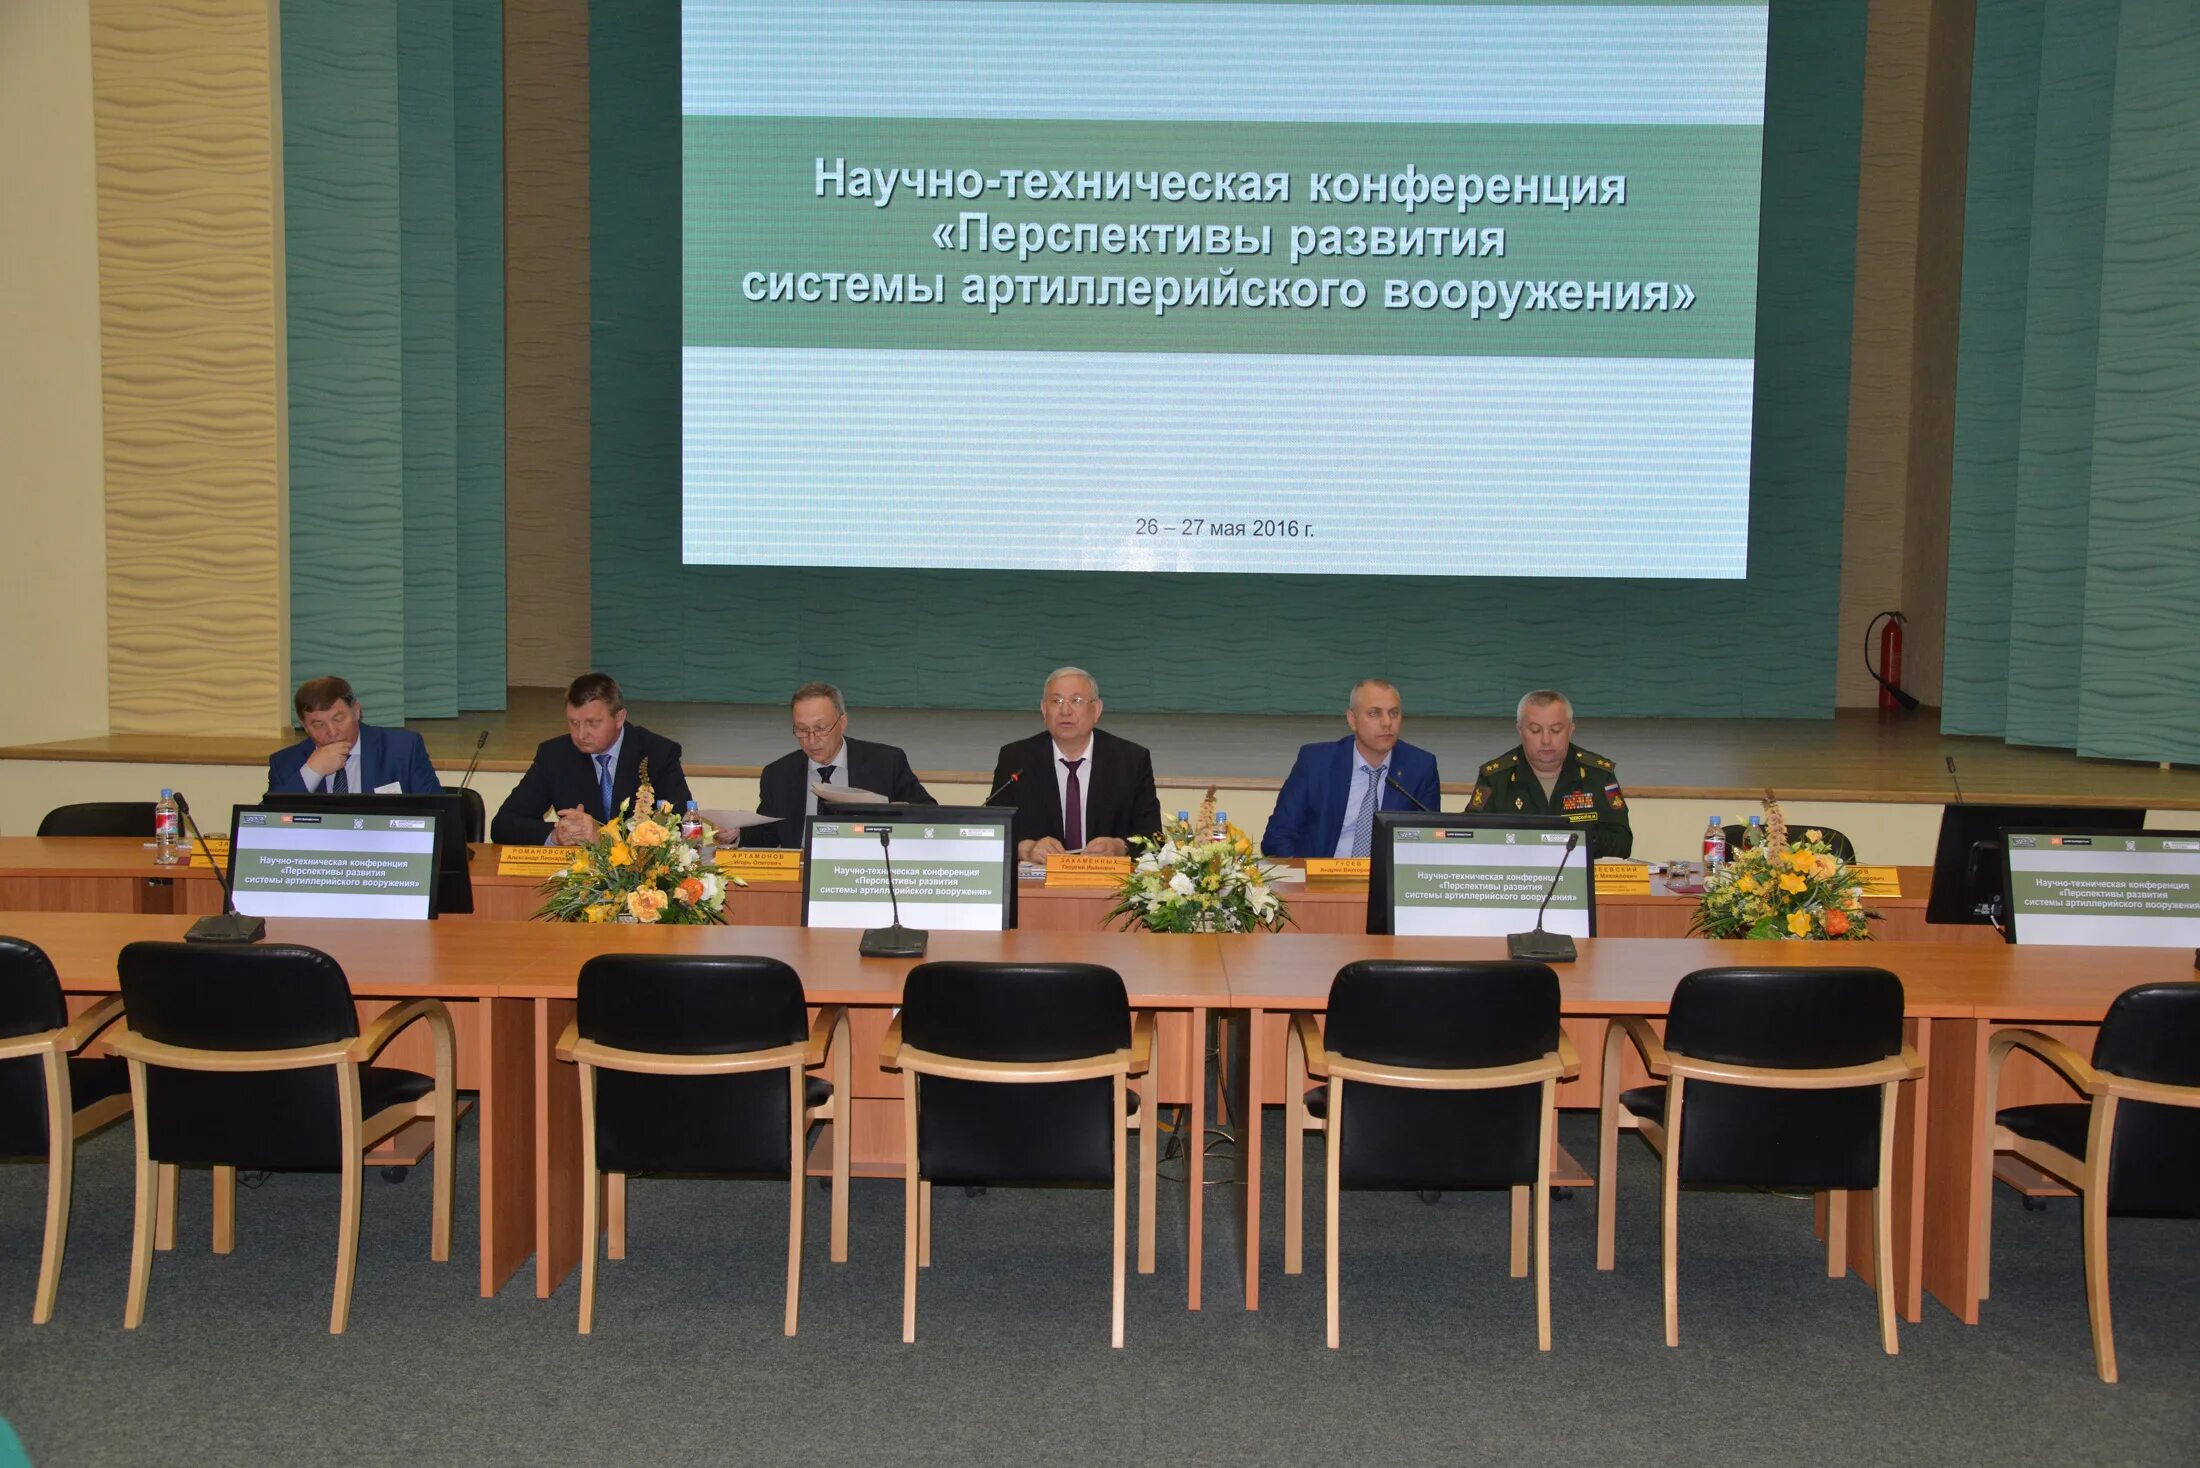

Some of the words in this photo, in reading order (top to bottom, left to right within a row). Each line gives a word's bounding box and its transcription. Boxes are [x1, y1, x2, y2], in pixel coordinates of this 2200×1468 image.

[814, 157, 1290, 208] Научно-техническая
[1310, 163, 1627, 214] конференция
[932, 211, 1272, 262] «Перспективы
[1290, 224, 1506, 265] развития
[742, 271, 944, 303] системы
[961, 266, 1367, 316] артиллерийского
[1384, 278, 1697, 320] вооружения»
[1135, 518, 1158, 535] 26
[1181, 518, 1205, 536] 27
[1210, 523, 1245, 537] мая
[1252, 519, 1299, 537] 2016
[1304, 524, 1314, 537] г.
[260, 856, 347, 866] Научно-техническая
[350, 859, 408, 868] конференция
[281, 866, 344, 877] «Перспективы
[346, 869, 386, 877] развития
[922, 868, 980, 878] конференция
[1418, 871, 1504, 881] Научно-техническая
[245, 876, 283, 884] системы
[285, 877, 360, 887] артиллерийского
[363, 879, 420, 888] вооружения»
[919, 878, 958, 887] развития
[1439, 881, 1501, 891] «Перспективы
[1503, 883, 1543, 892] развития
[2036, 878, 2126, 888] Научно-техническая
[2129, 881, 2190, 890] конференция
[820, 886, 858, 894] системы
[936, 888, 992, 898] вооружения»
[1405, 891, 1442, 899] системы
[1445, 891, 1518, 901] артиллерийского
[1521, 893, 1577, 902] вооруения»
[2059, 889, 2124, 899] «Перспективы
[2126, 891, 2168, 900] развития
[2024, 898, 2063, 907] системы
[2066, 899, 2143, 909] артиллерийского
